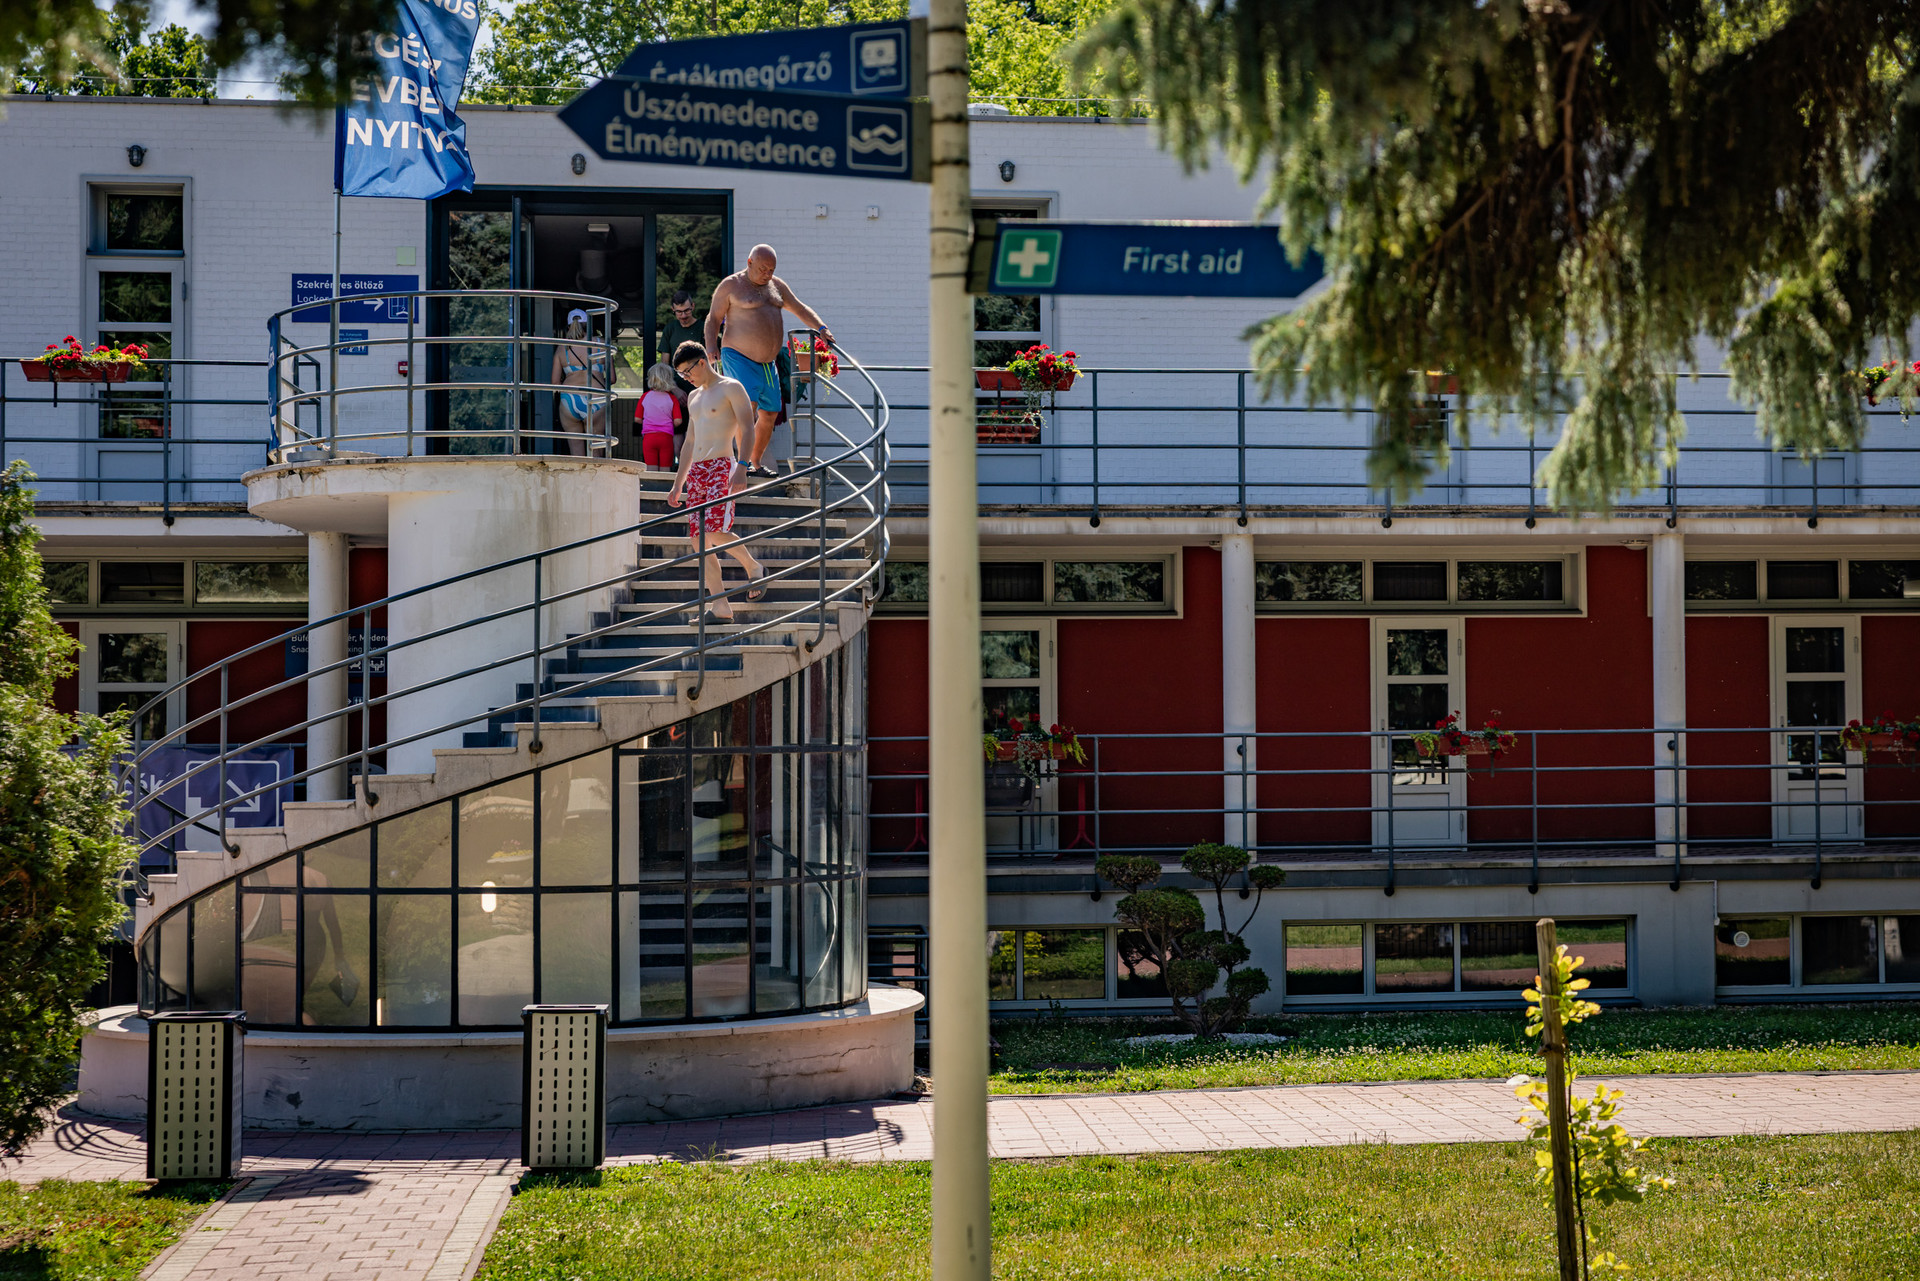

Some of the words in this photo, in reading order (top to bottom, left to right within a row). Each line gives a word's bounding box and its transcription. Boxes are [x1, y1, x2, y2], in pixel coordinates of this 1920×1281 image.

[624, 81, 819, 132] Úszómedence
[605, 115, 837, 168] Élménymedence
[1123, 246, 1190, 274] First
[1198, 247, 1243, 275] aid
